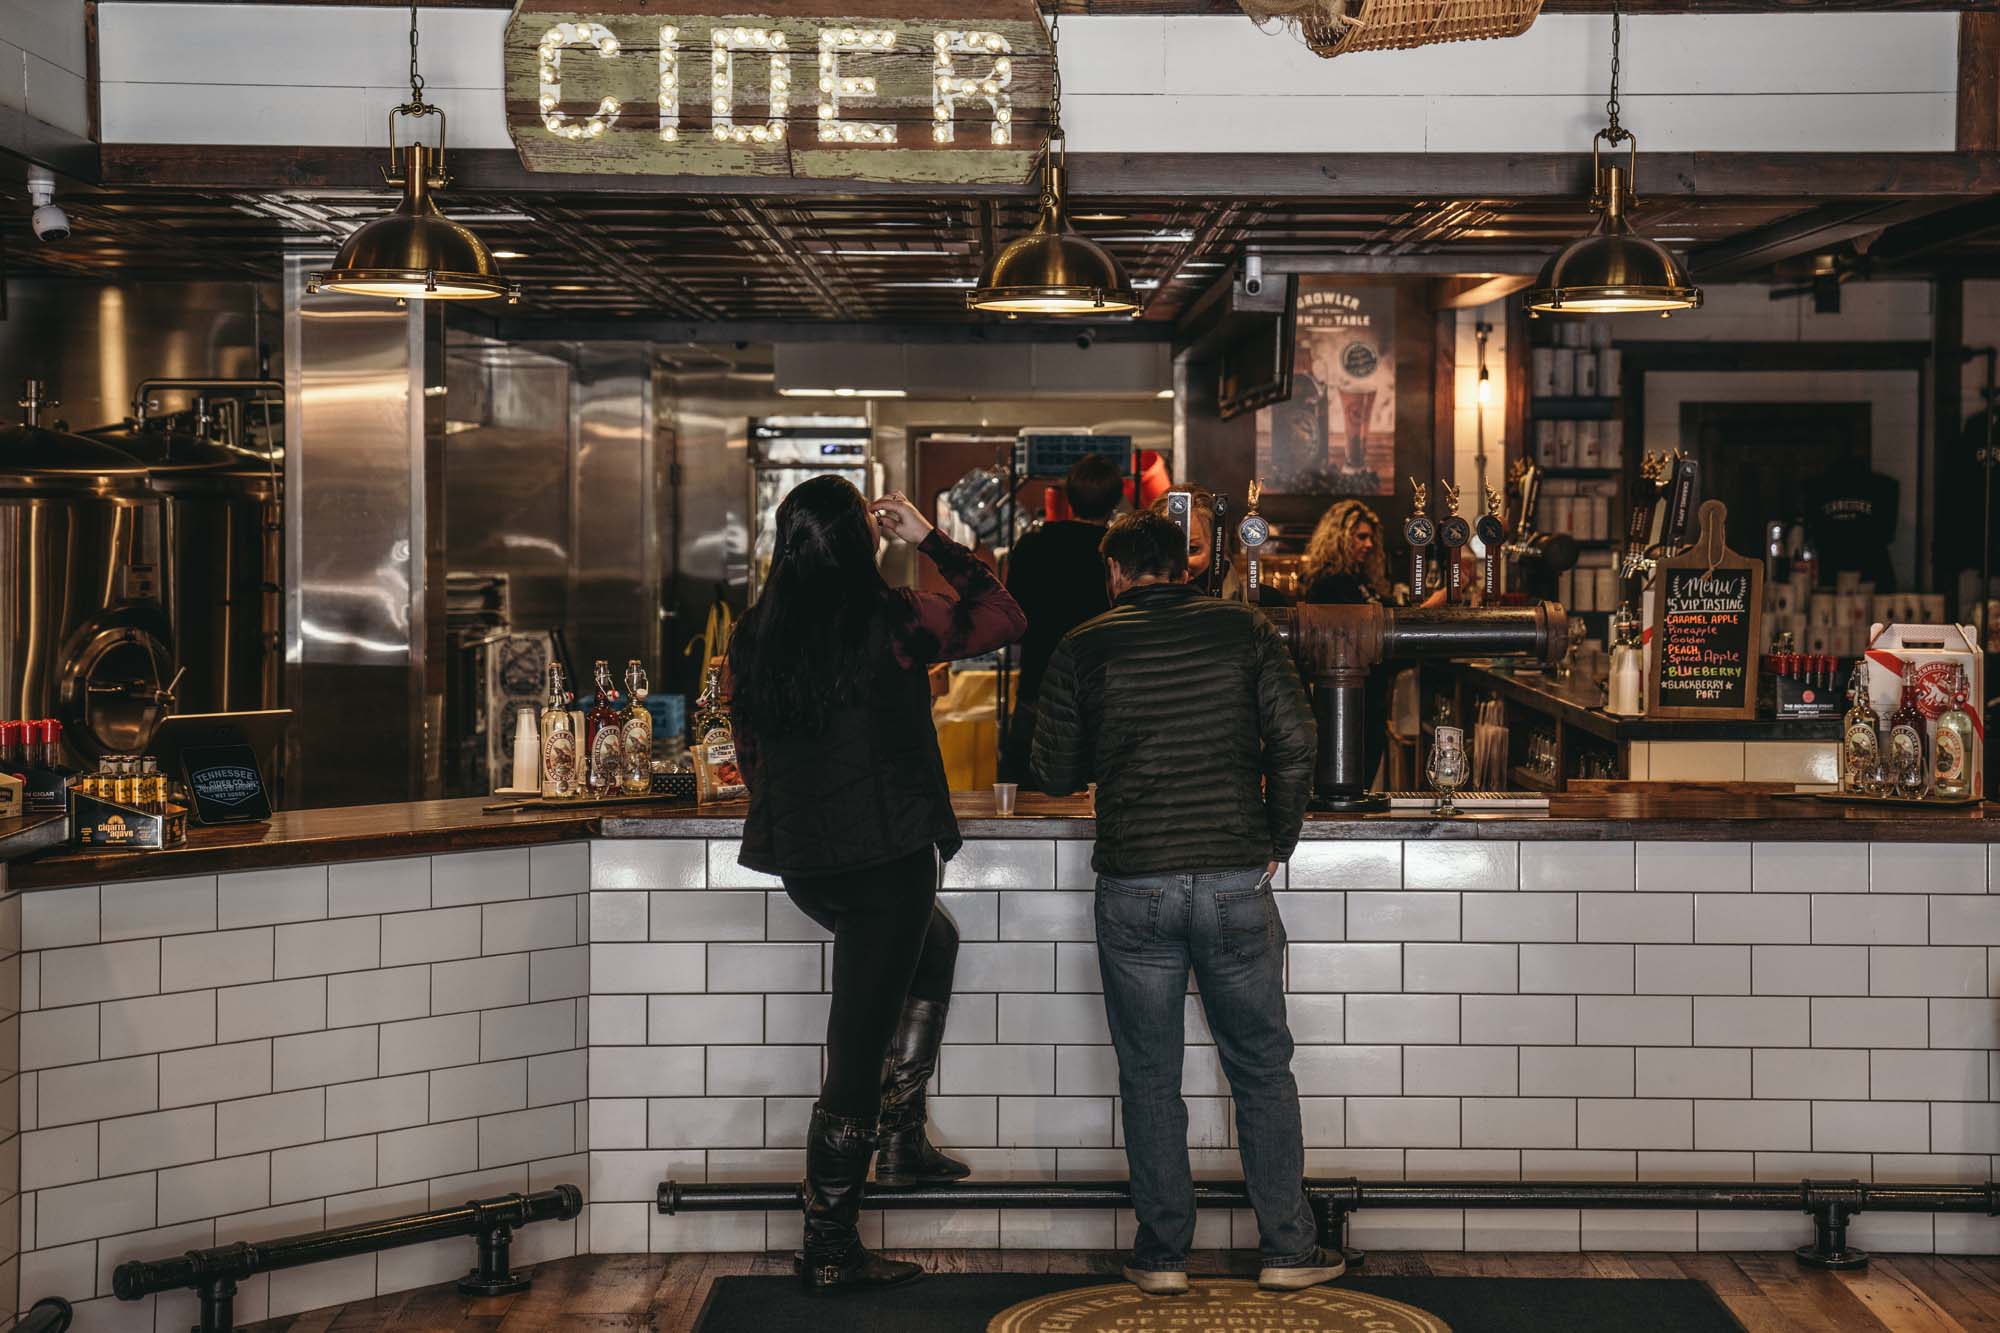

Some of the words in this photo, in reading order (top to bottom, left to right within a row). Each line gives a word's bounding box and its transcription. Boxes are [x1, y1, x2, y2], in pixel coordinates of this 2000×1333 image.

[539, 22, 1012, 144] CIDER
[1335, 315, 1370, 326] TABLE
[1415, 554, 1423, 595] BLUEBERRY
[1680, 599, 1700, 610] VIP
[1700, 599, 1744, 611] TASTING
[1666, 614, 1707, 625] CARAMEL
[1711, 614, 1739, 625] APPLE
[1667, 625, 1718, 636] Pineapple
[1670, 634, 1706, 645] Golden
[1667, 643, 1698, 655] PEACH
[1669, 651, 1701, 664] Spiced
[1704, 649, 1740, 665] Apple
[1668, 666, 1742, 677] BLUEBERRY
[1667, 680, 1724, 690] BLACKBERRY
[1696, 690, 1721, 699] PORT
[195, 769, 253, 783] TENNESSEE
[110, 830, 134, 840] agave
[1252, 1291, 1376, 1318] CIDER
[1116, 1318, 1152, 1326] OF
[1170, 1318, 1320, 1326] SPIRITED
